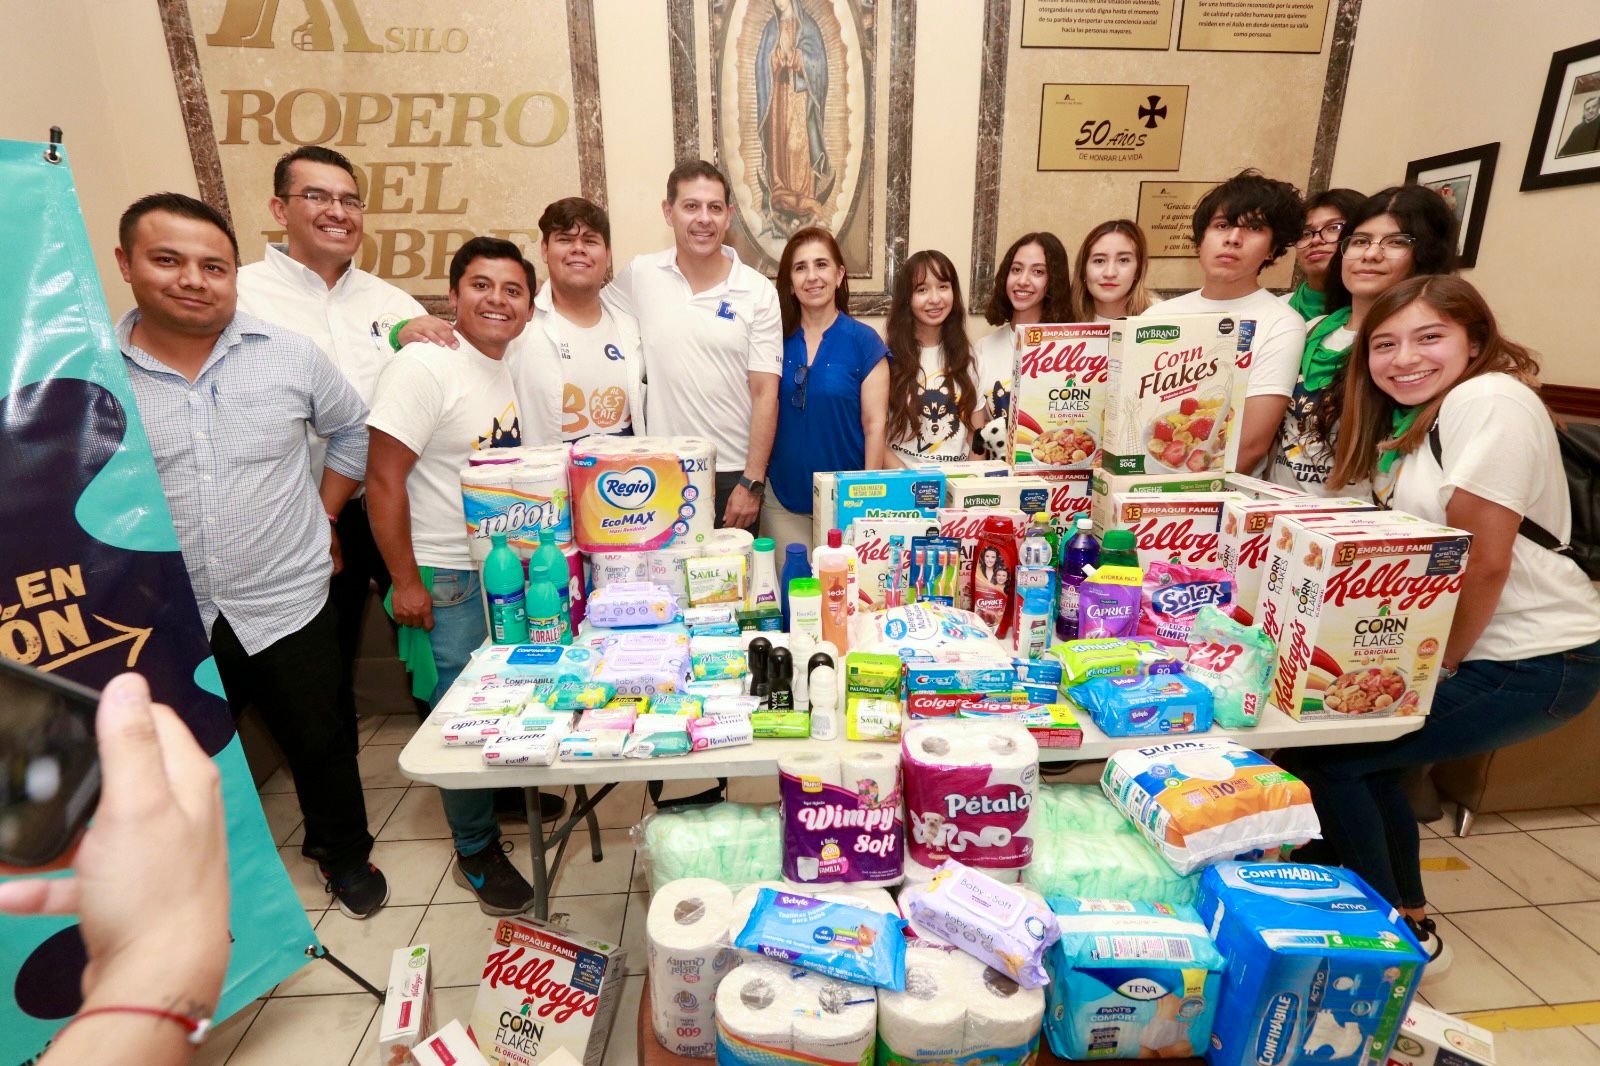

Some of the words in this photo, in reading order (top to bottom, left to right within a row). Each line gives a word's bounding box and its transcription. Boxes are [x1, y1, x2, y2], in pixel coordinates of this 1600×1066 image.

[219, 88, 570, 148] ROPERO
[1074, 119, 1111, 146] 50
[1106, 128, 1148, 147] AÑOS
[1079, 152, 1089, 161] DE
[1089, 153, 1118, 162] HONRAR
[1118, 154, 1128, 162] LA
[1128, 152, 1144, 161] VIDA
[1151, 222, 1179, 230] voluntad
[1028, 330, 1042, 344] 13
[1042, 329, 1080, 338] EMPAQUE
[1153, 345, 1205, 372] Corn
[1138, 357, 1219, 400] Flakes
[1048, 387, 1092, 401] CORN
[1048, 400, 1090, 412] FLAKES
[678, 458, 696, 474] 12
[696, 460, 709, 473] XL
[1119, 460, 1137, 469] 500g
[605, 478, 649, 497] Regio
[601, 510, 656, 529] EcoMAX
[1126, 508, 1142, 519] 13
[608, 526, 623, 534] Maxi
[1250, 517, 1267, 530] 13
[1339, 546, 1356, 562] 13
[1356, 544, 1405, 555] EMPAQUE
[1267, 554, 1283, 592] CORN
[15, 564, 87, 609] EN
[976, 598, 1003, 606] CAPRICE
[1162, 582, 1223, 614] Solex
[1296, 577, 1312, 614] CORN
[1305, 582, 1320, 618] FLAKES
[1086, 604, 1133, 618] CAPRICE
[1354, 616, 1409, 635] CORN
[1353, 632, 1404, 648] FLAKES
[1363, 648, 1398, 656] ORIGINAL
[1273, 617, 1311, 716] Kellogg's
[849, 685, 882, 694] PALMOLIVE
[960, 700, 1031, 712] Colgate
[1243, 692, 1257, 716] 123
[505, 755, 529, 765] Escudo
[1214, 781, 1236, 800] 10
[944, 790, 1033, 819] Pétalo
[797, 804, 896, 832] Wimpy
[853, 833, 897, 858] Soft
[819, 865, 841, 874] FAMILIA
[1238, 866, 1334, 883] CONFIHABILE
[1330, 902, 1368, 911] ACTIVO
[500, 925, 513, 942] 13
[513, 930, 552, 950] EMPAQUE
[666, 956, 706, 968] Quality
[481, 946, 600, 1025] Kelloggs
[1127, 984, 1157, 995] TENA
[499, 1010, 545, 1042] CORN
[1090, 1014, 1137, 1022] COMFORT
[676, 1027, 702, 1038] 600
[1257, 994, 1292, 1066] CONFIHABILE
[495, 1026, 539, 1058] FLAKES
[502, 1049, 531, 1066] ORIGINAL
